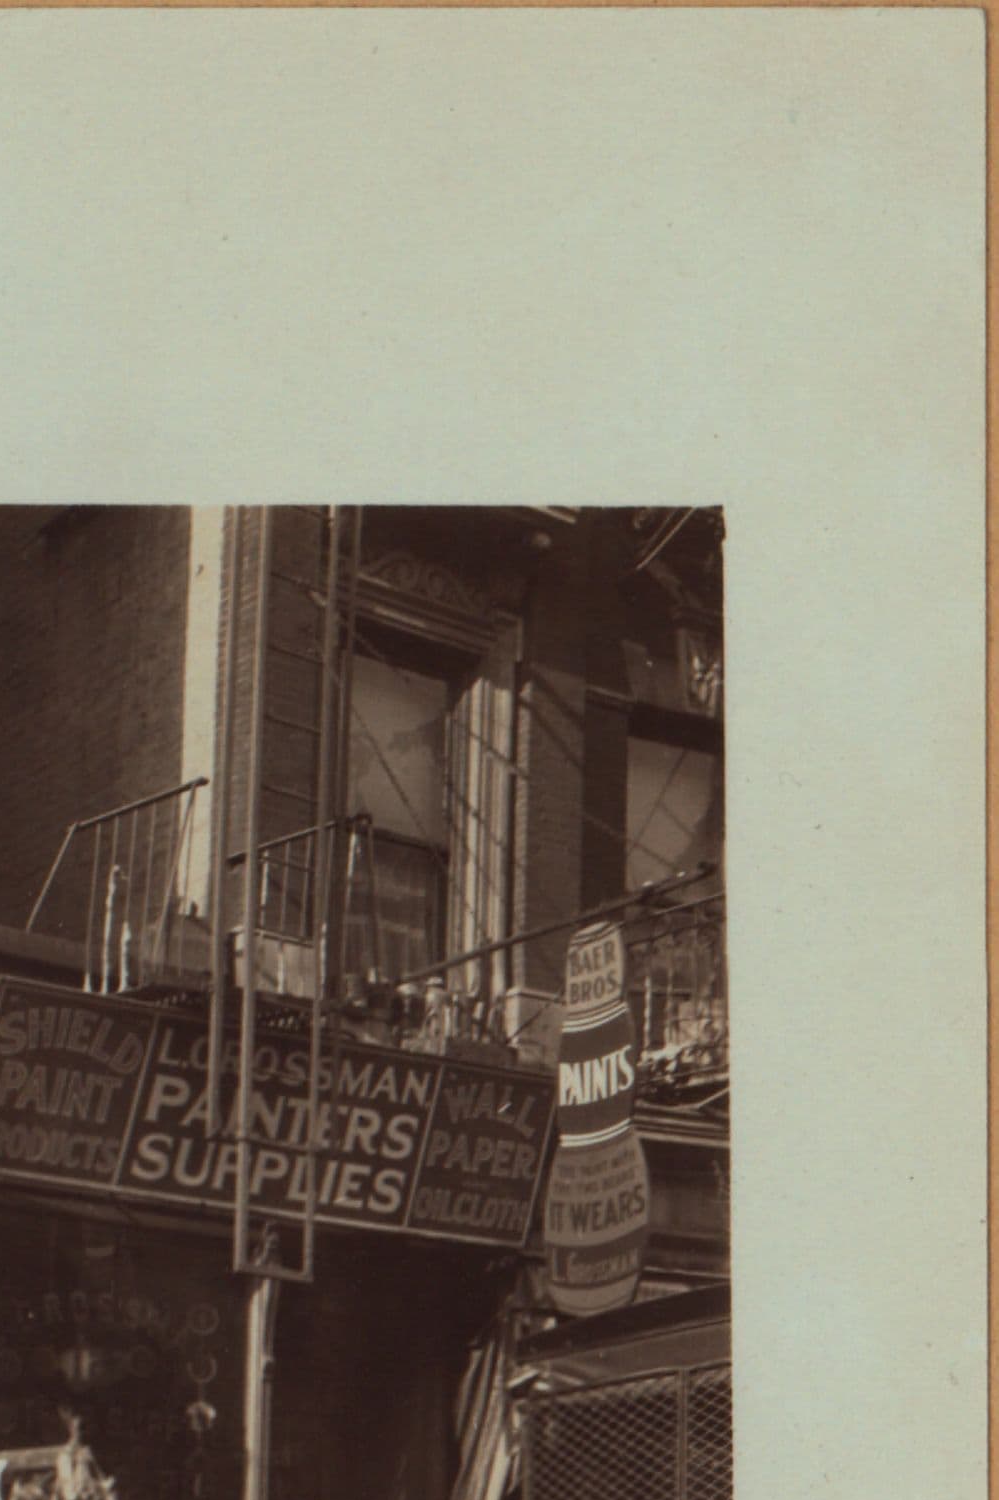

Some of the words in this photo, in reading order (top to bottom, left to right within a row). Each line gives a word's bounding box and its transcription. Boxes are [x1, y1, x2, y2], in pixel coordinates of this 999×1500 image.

[569, 941, 615, 977] BAER
[560, 1045, 634, 1106] PAINTS
[145, 1074, 418, 1160] PAINTERS
[444, 1079, 537, 1138] WALL
[131, 1133, 407, 1214] SUPPLIES
[426, 1129, 537, 1180] PAPER
[413, 1187, 529, 1231] OILCLOTH
[549, 1201, 565, 1233] IT
[570, 1184, 646, 1233] WEARS
